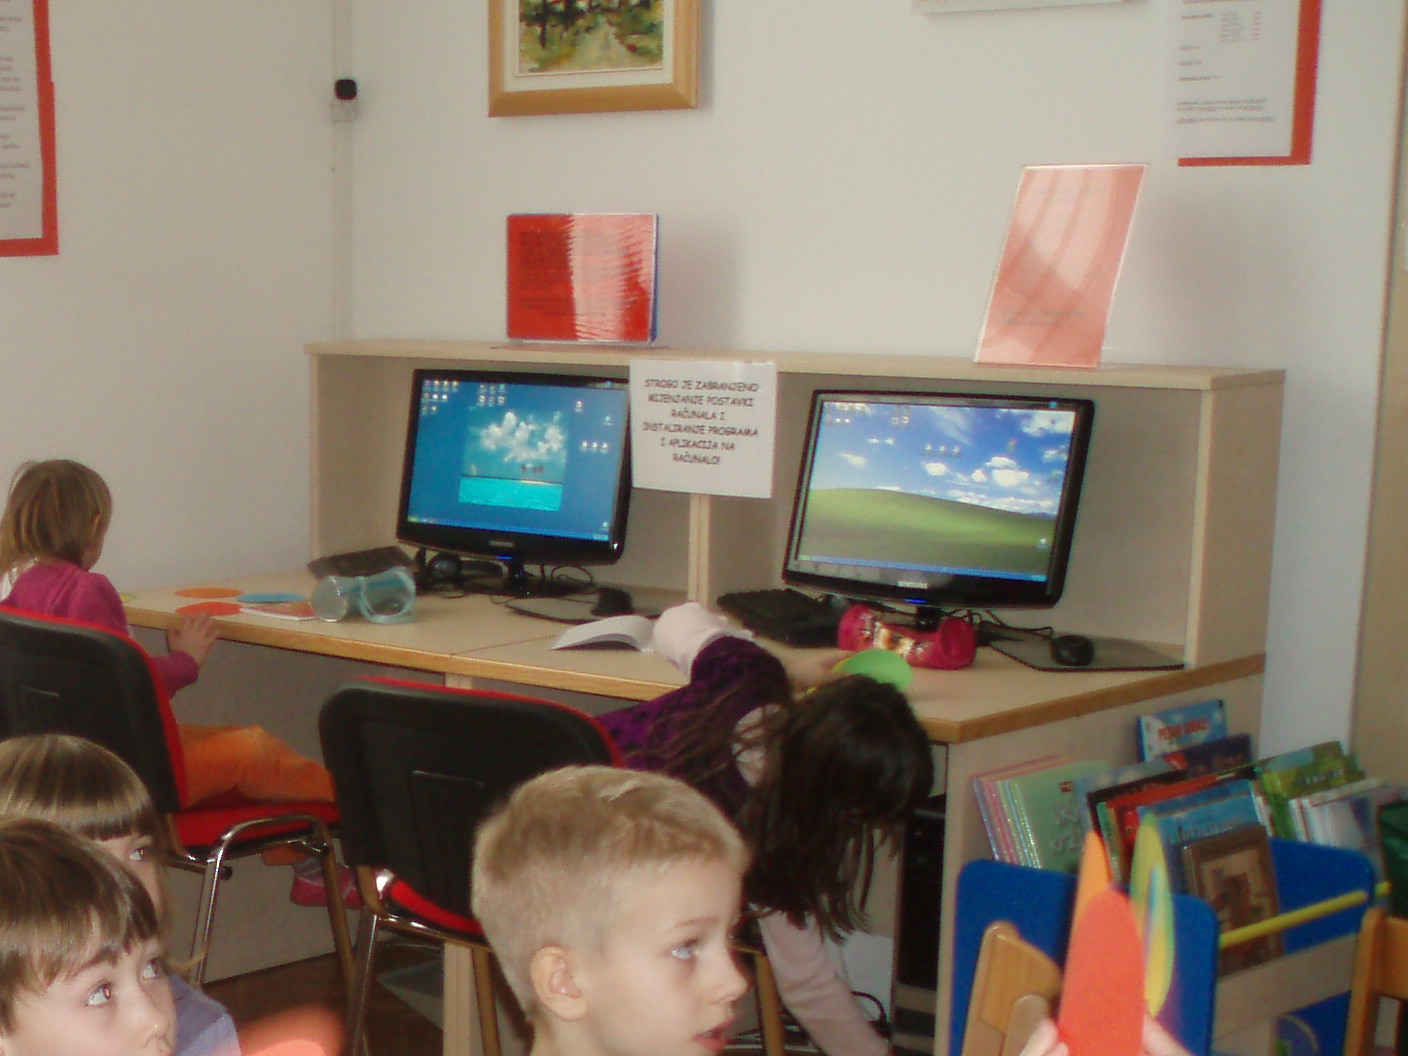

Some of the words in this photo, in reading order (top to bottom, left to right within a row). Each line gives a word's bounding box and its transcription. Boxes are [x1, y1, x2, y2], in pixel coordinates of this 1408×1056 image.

[644, 379, 678, 389] STROGO
[682, 380, 693, 390] JE
[695, 380, 759, 392] ZABRANJENO
[671, 407, 717, 420] RAČUNALA
[708, 426, 759, 437] PROGRAMA
[668, 438, 718, 449] APLIKACIJA
